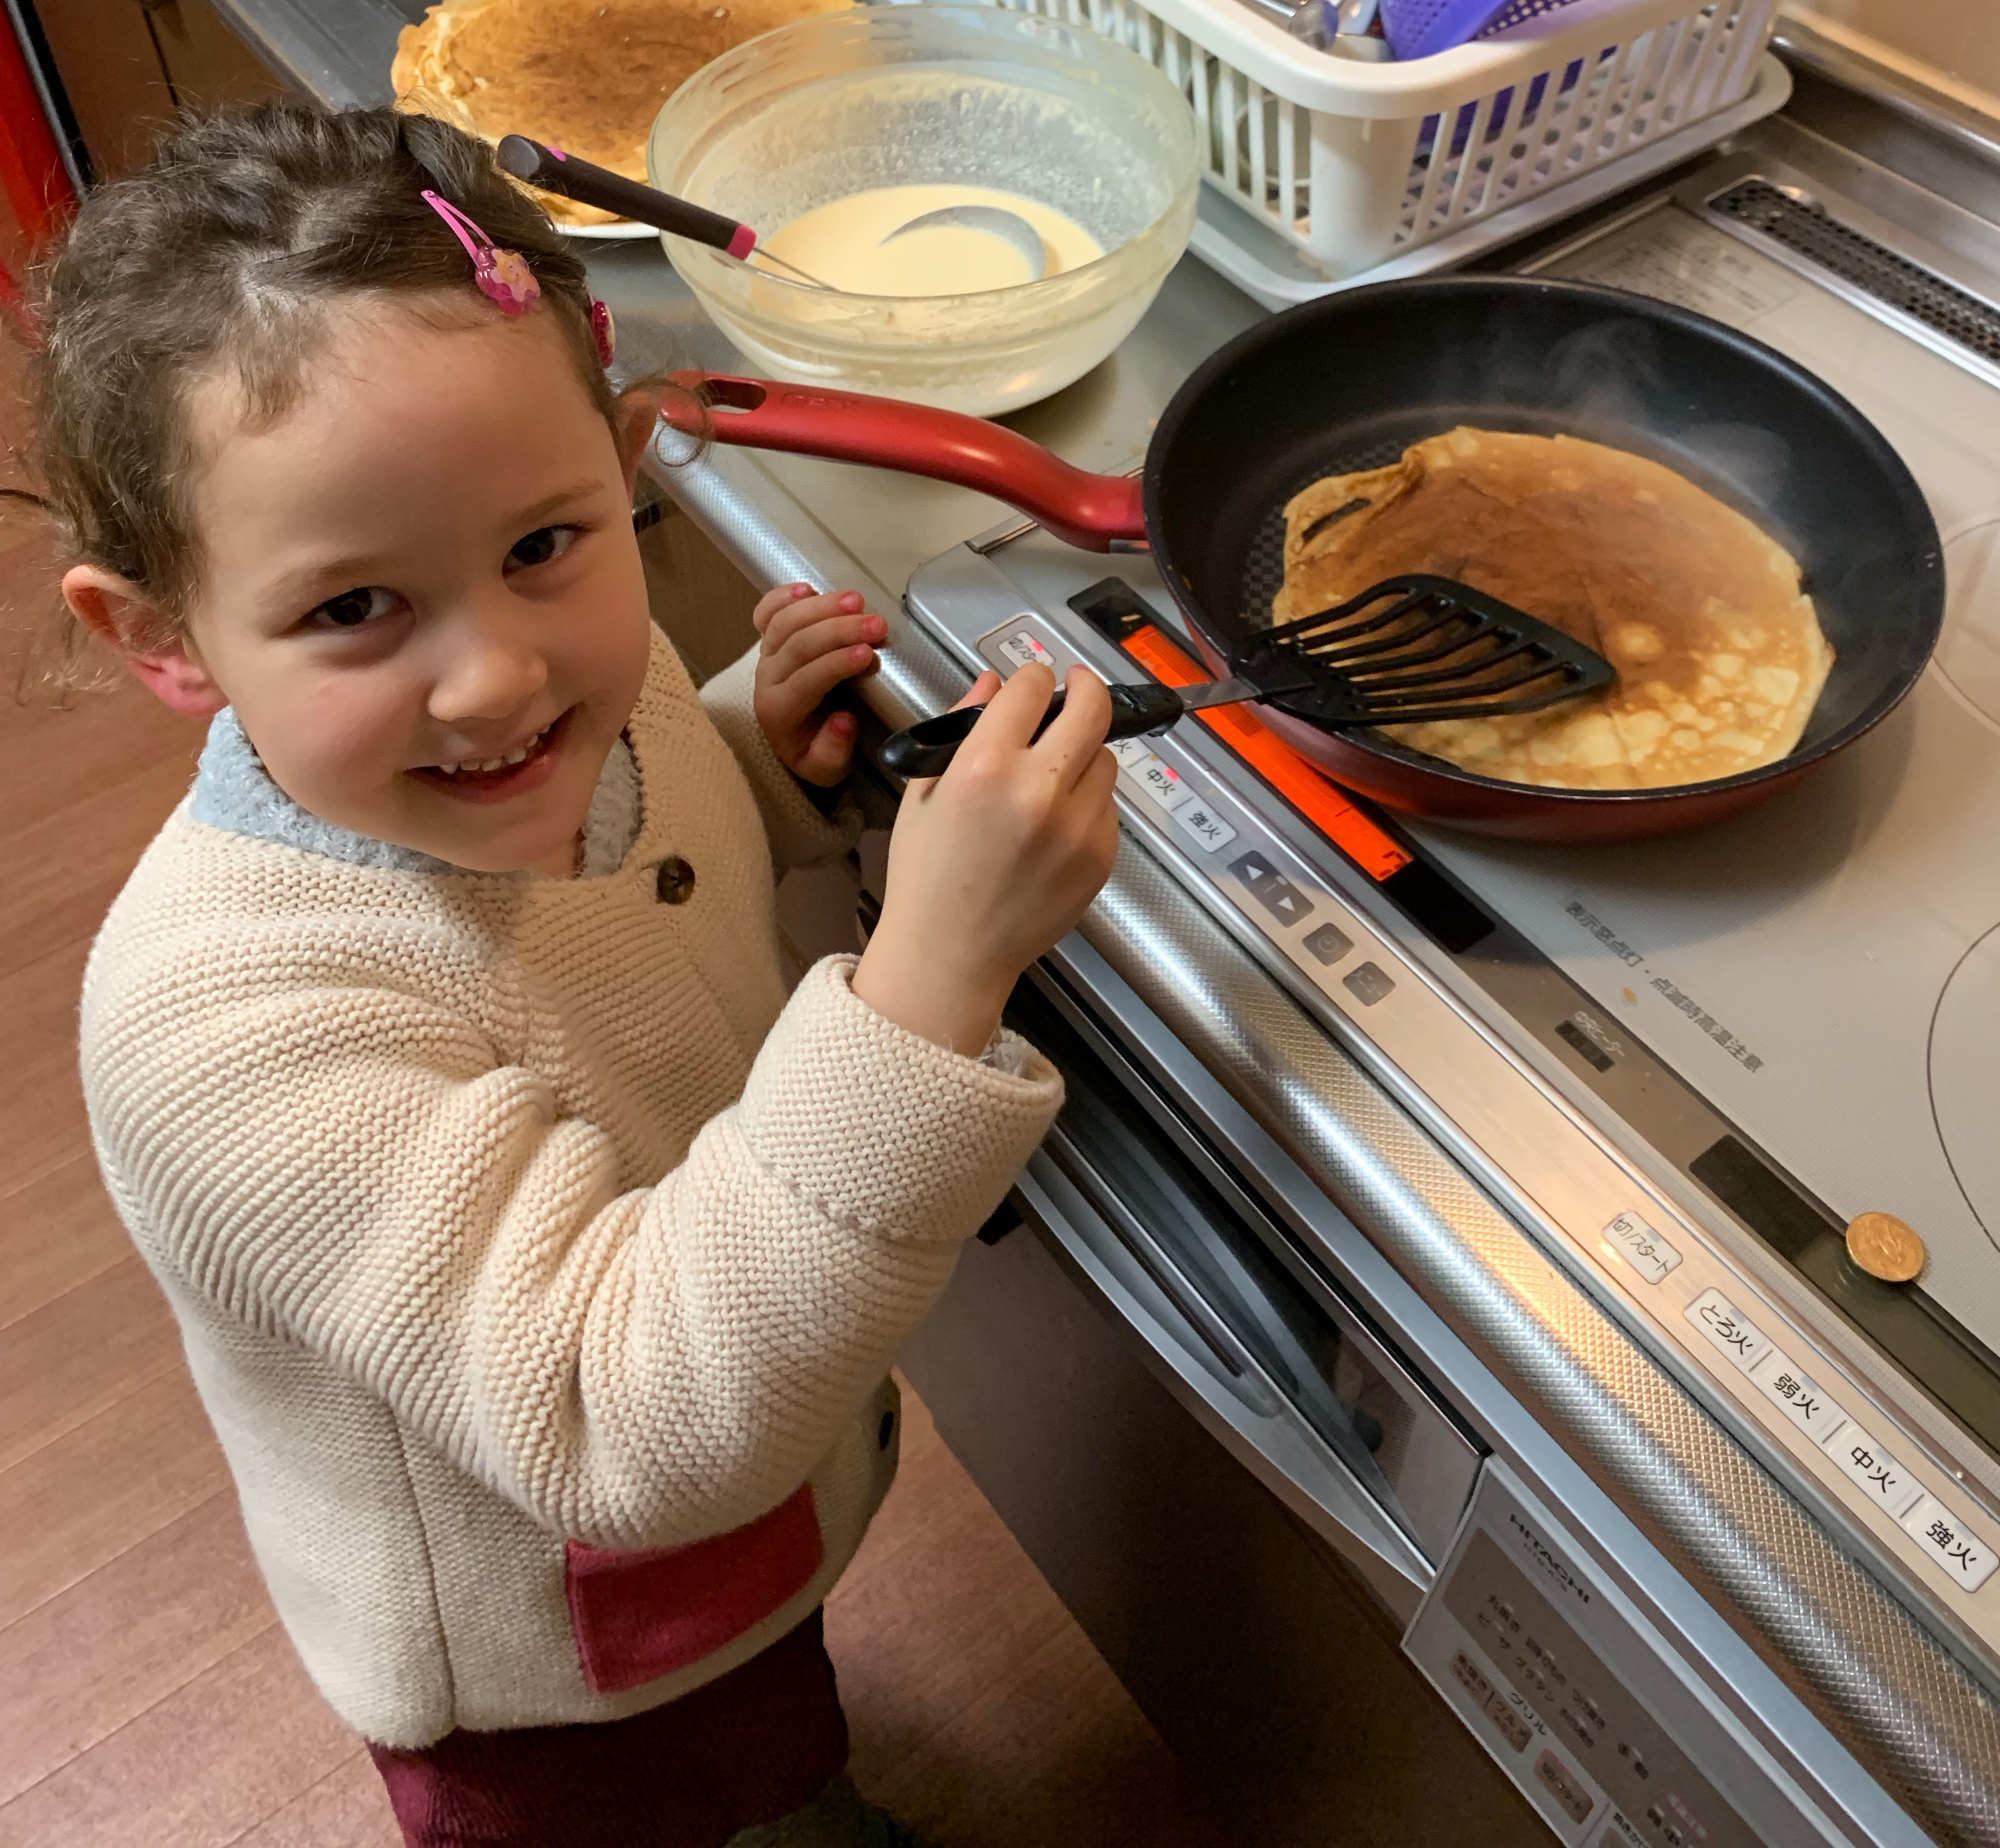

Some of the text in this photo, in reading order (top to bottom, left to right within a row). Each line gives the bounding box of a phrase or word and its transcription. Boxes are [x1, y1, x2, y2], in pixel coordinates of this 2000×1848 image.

[1146, 768, 1177, 798] 中火
[1189, 811, 1222, 841] 強火
[1612, 1217, 1671, 1275] 切/スタート
[1699, 1305, 1754, 1356] とろ火
[1773, 1372, 1821, 1421] 弱火
[1850, 1446, 1897, 1494] 中火
[1509, 1513, 1591, 1604] HITACHI
[1925, 1519, 1978, 1572] 強火
